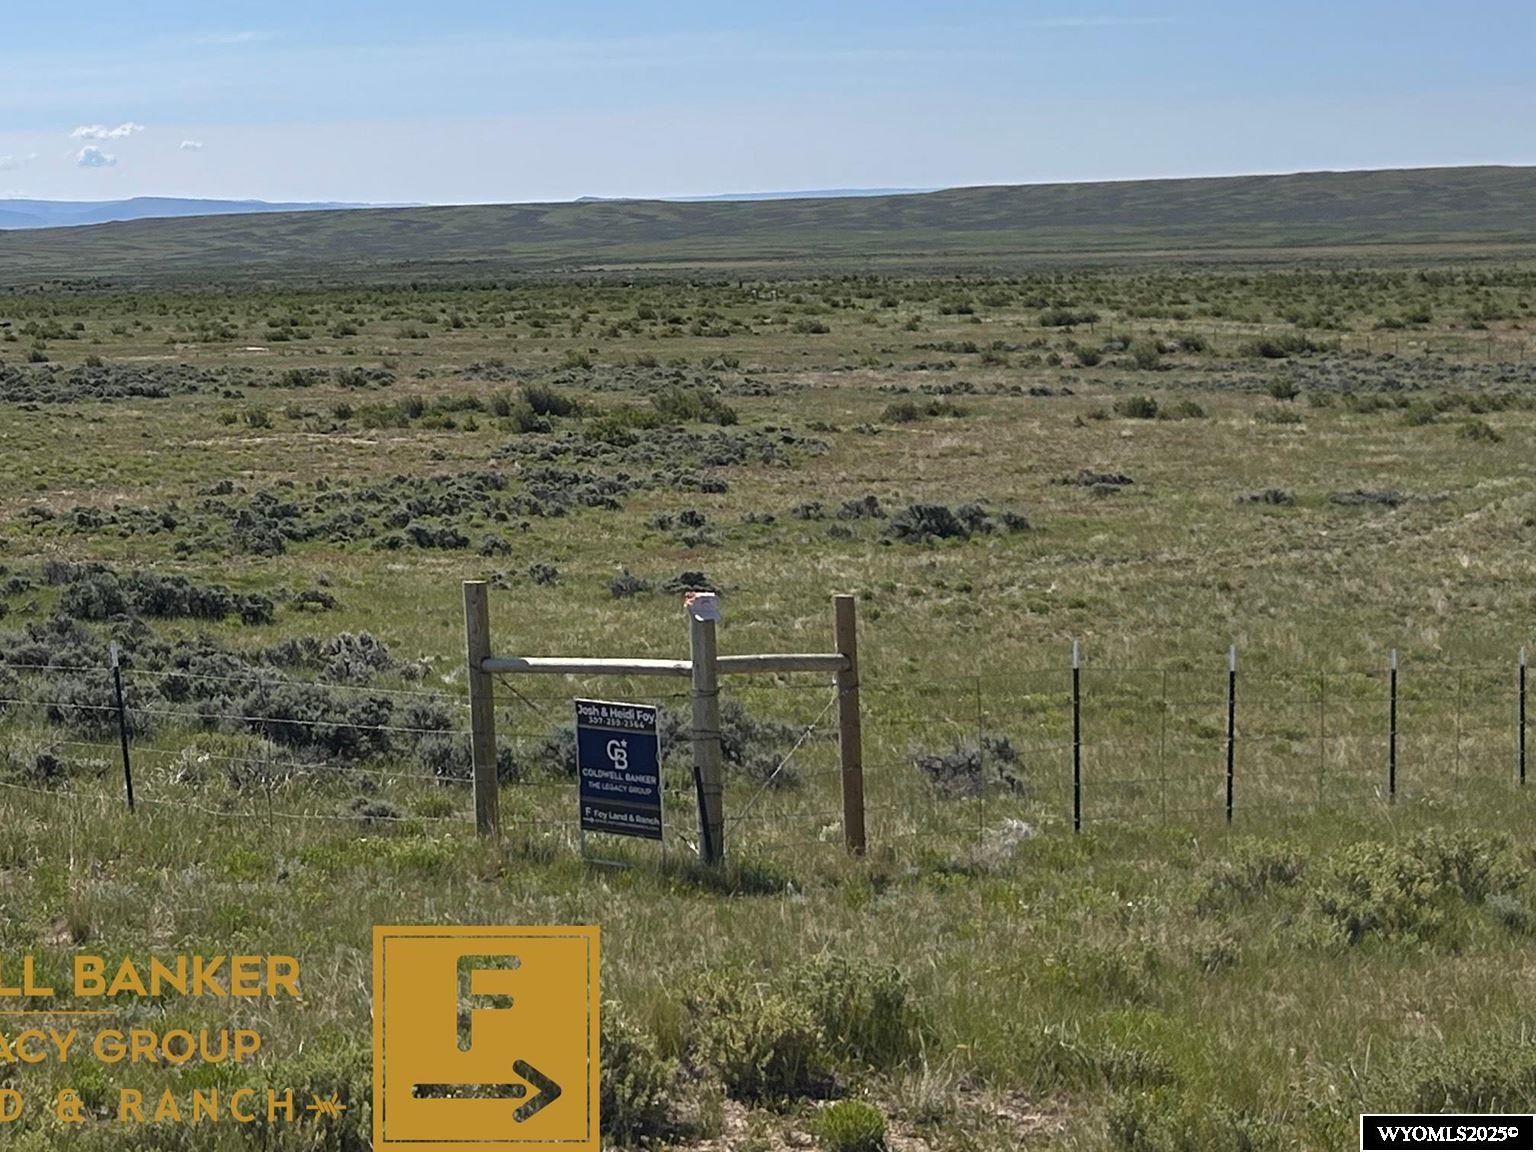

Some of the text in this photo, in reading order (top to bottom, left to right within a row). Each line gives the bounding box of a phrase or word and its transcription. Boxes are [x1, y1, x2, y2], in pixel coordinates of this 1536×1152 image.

[578, 704, 655, 725] Josh & Heidi Foy
[582, 768, 657, 785] COLDWELL BANKER
[588, 781, 652, 796] THE LEGACY GROUP
[594, 810, 607, 820] Foy
[608, 811, 628, 822] Land
[628, 814, 635, 823] &
[635, 815, 660, 826] Ranch
